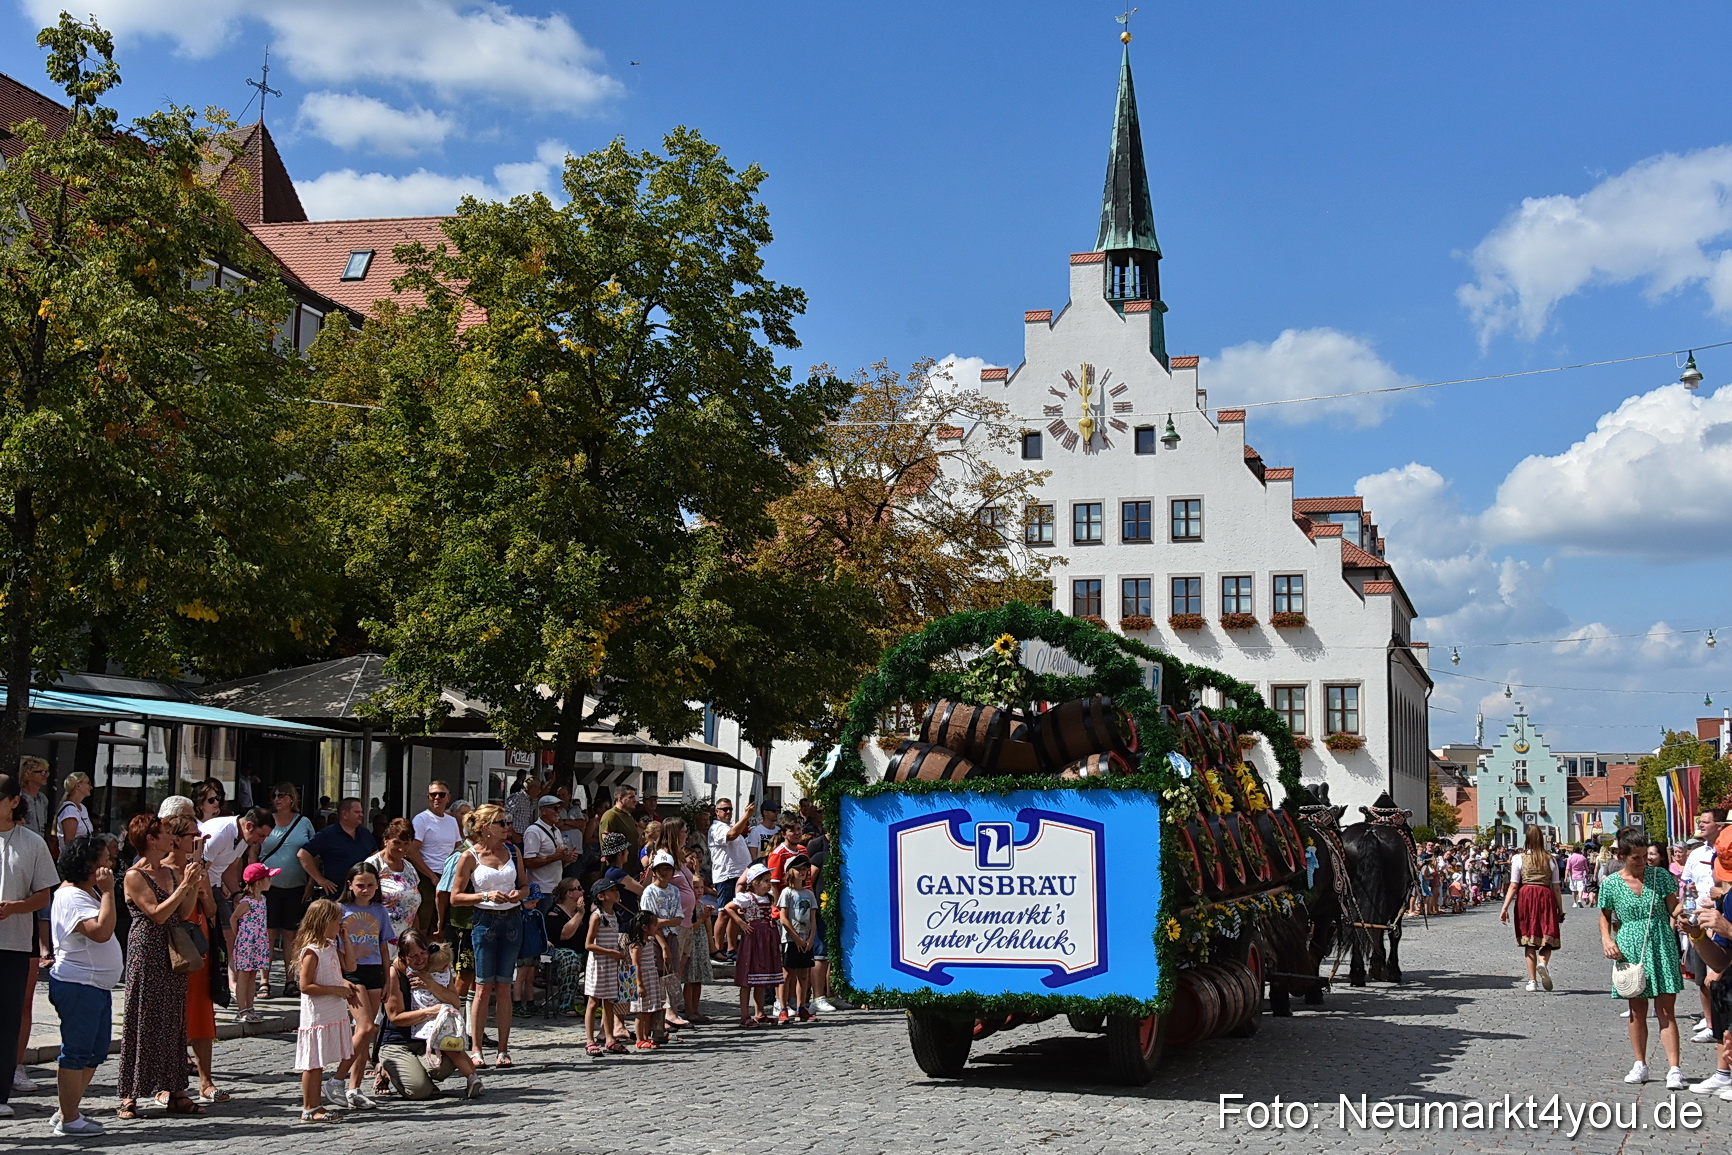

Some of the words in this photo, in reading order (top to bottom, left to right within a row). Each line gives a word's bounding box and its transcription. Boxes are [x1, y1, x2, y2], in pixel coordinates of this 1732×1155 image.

[916, 875, 1076, 895] GANSBRÄU
[927, 899, 1065, 929] Neumarkt's
[917, 929, 976, 955] guter
[976, 927, 1076, 955] Schluck
